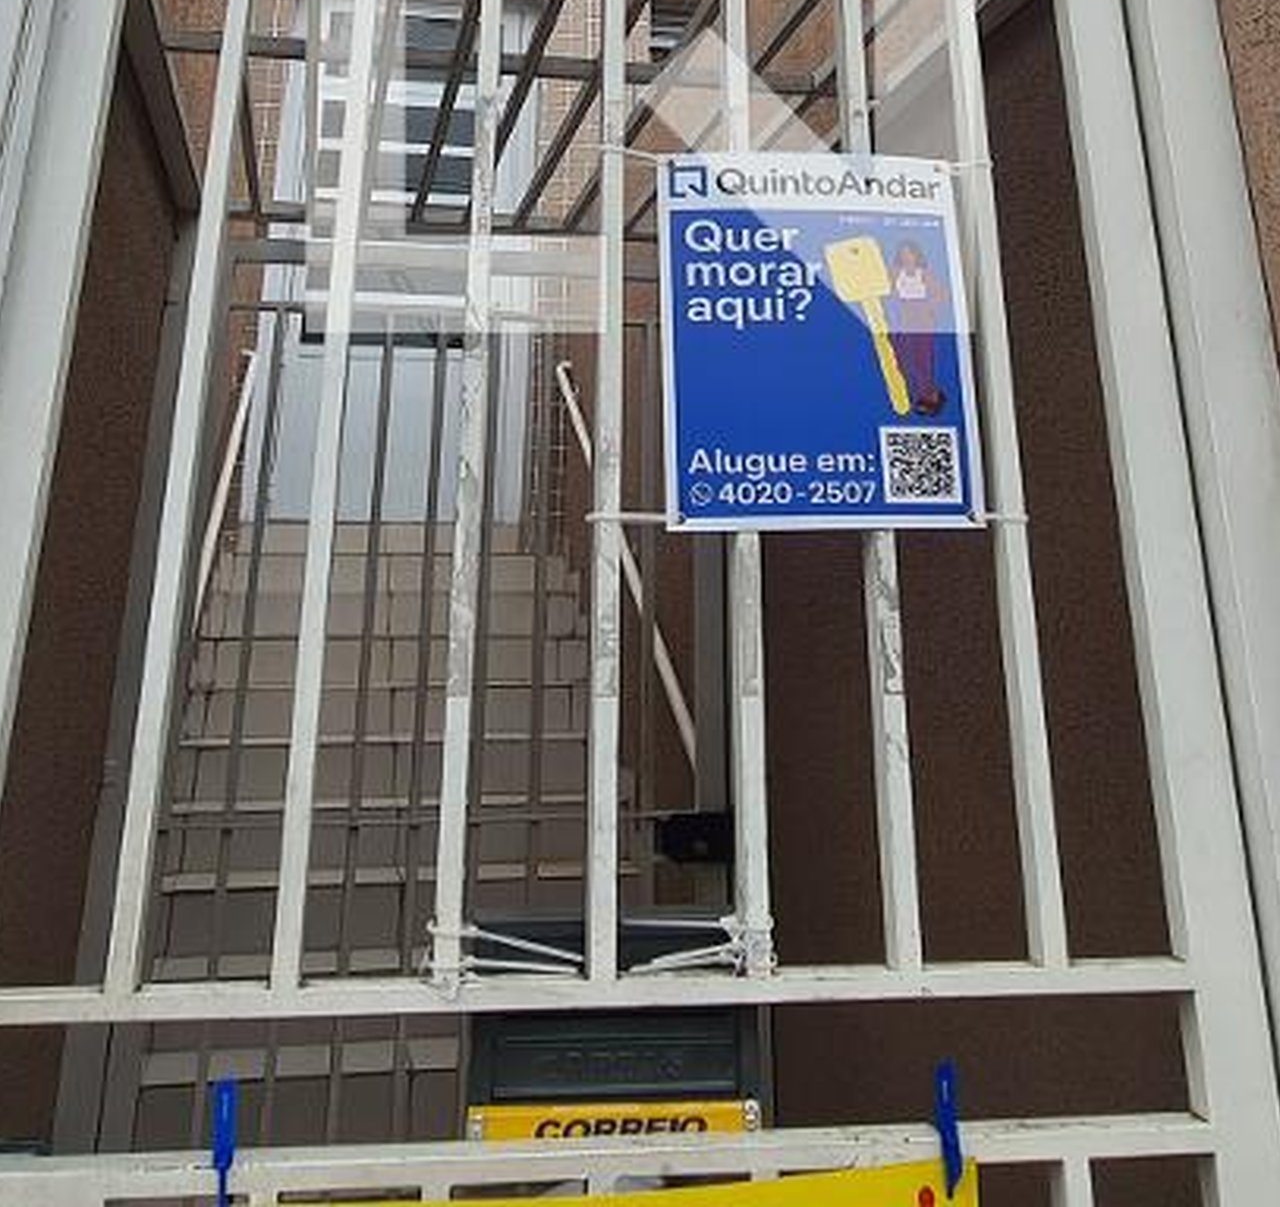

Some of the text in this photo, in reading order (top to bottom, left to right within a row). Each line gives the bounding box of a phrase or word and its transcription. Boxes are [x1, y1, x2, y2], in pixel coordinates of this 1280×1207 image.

[716, 168, 942, 200] QuintoAndar
[684, 219, 801, 253] Quer
[686, 260, 824, 288] morar
[686, 288, 813, 330] aqui?
[688, 448, 876, 481] Alugue em:
[718, 481, 876, 505] 4020-2507
